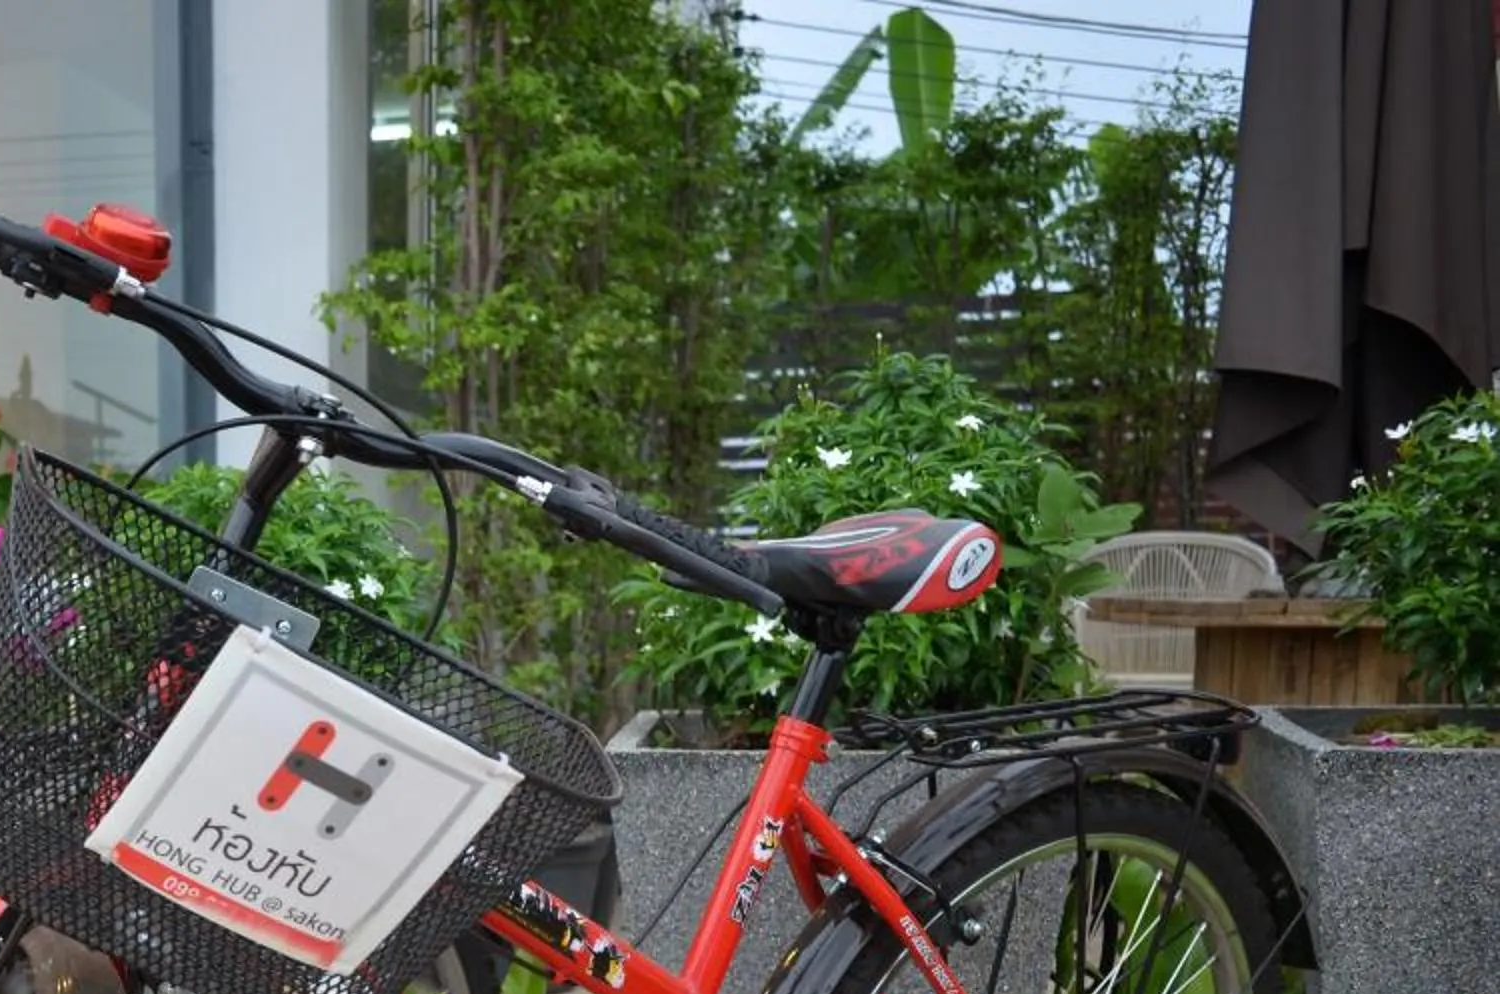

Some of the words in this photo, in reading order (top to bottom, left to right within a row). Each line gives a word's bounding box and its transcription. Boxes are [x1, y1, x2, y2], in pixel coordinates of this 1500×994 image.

[135, 830, 209, 875] HONG
[211, 869, 262, 902] HUB
[261, 896, 284, 912] @
[284, 907, 346, 939] sakon
[192, 804, 332, 897] ห้องหับ
